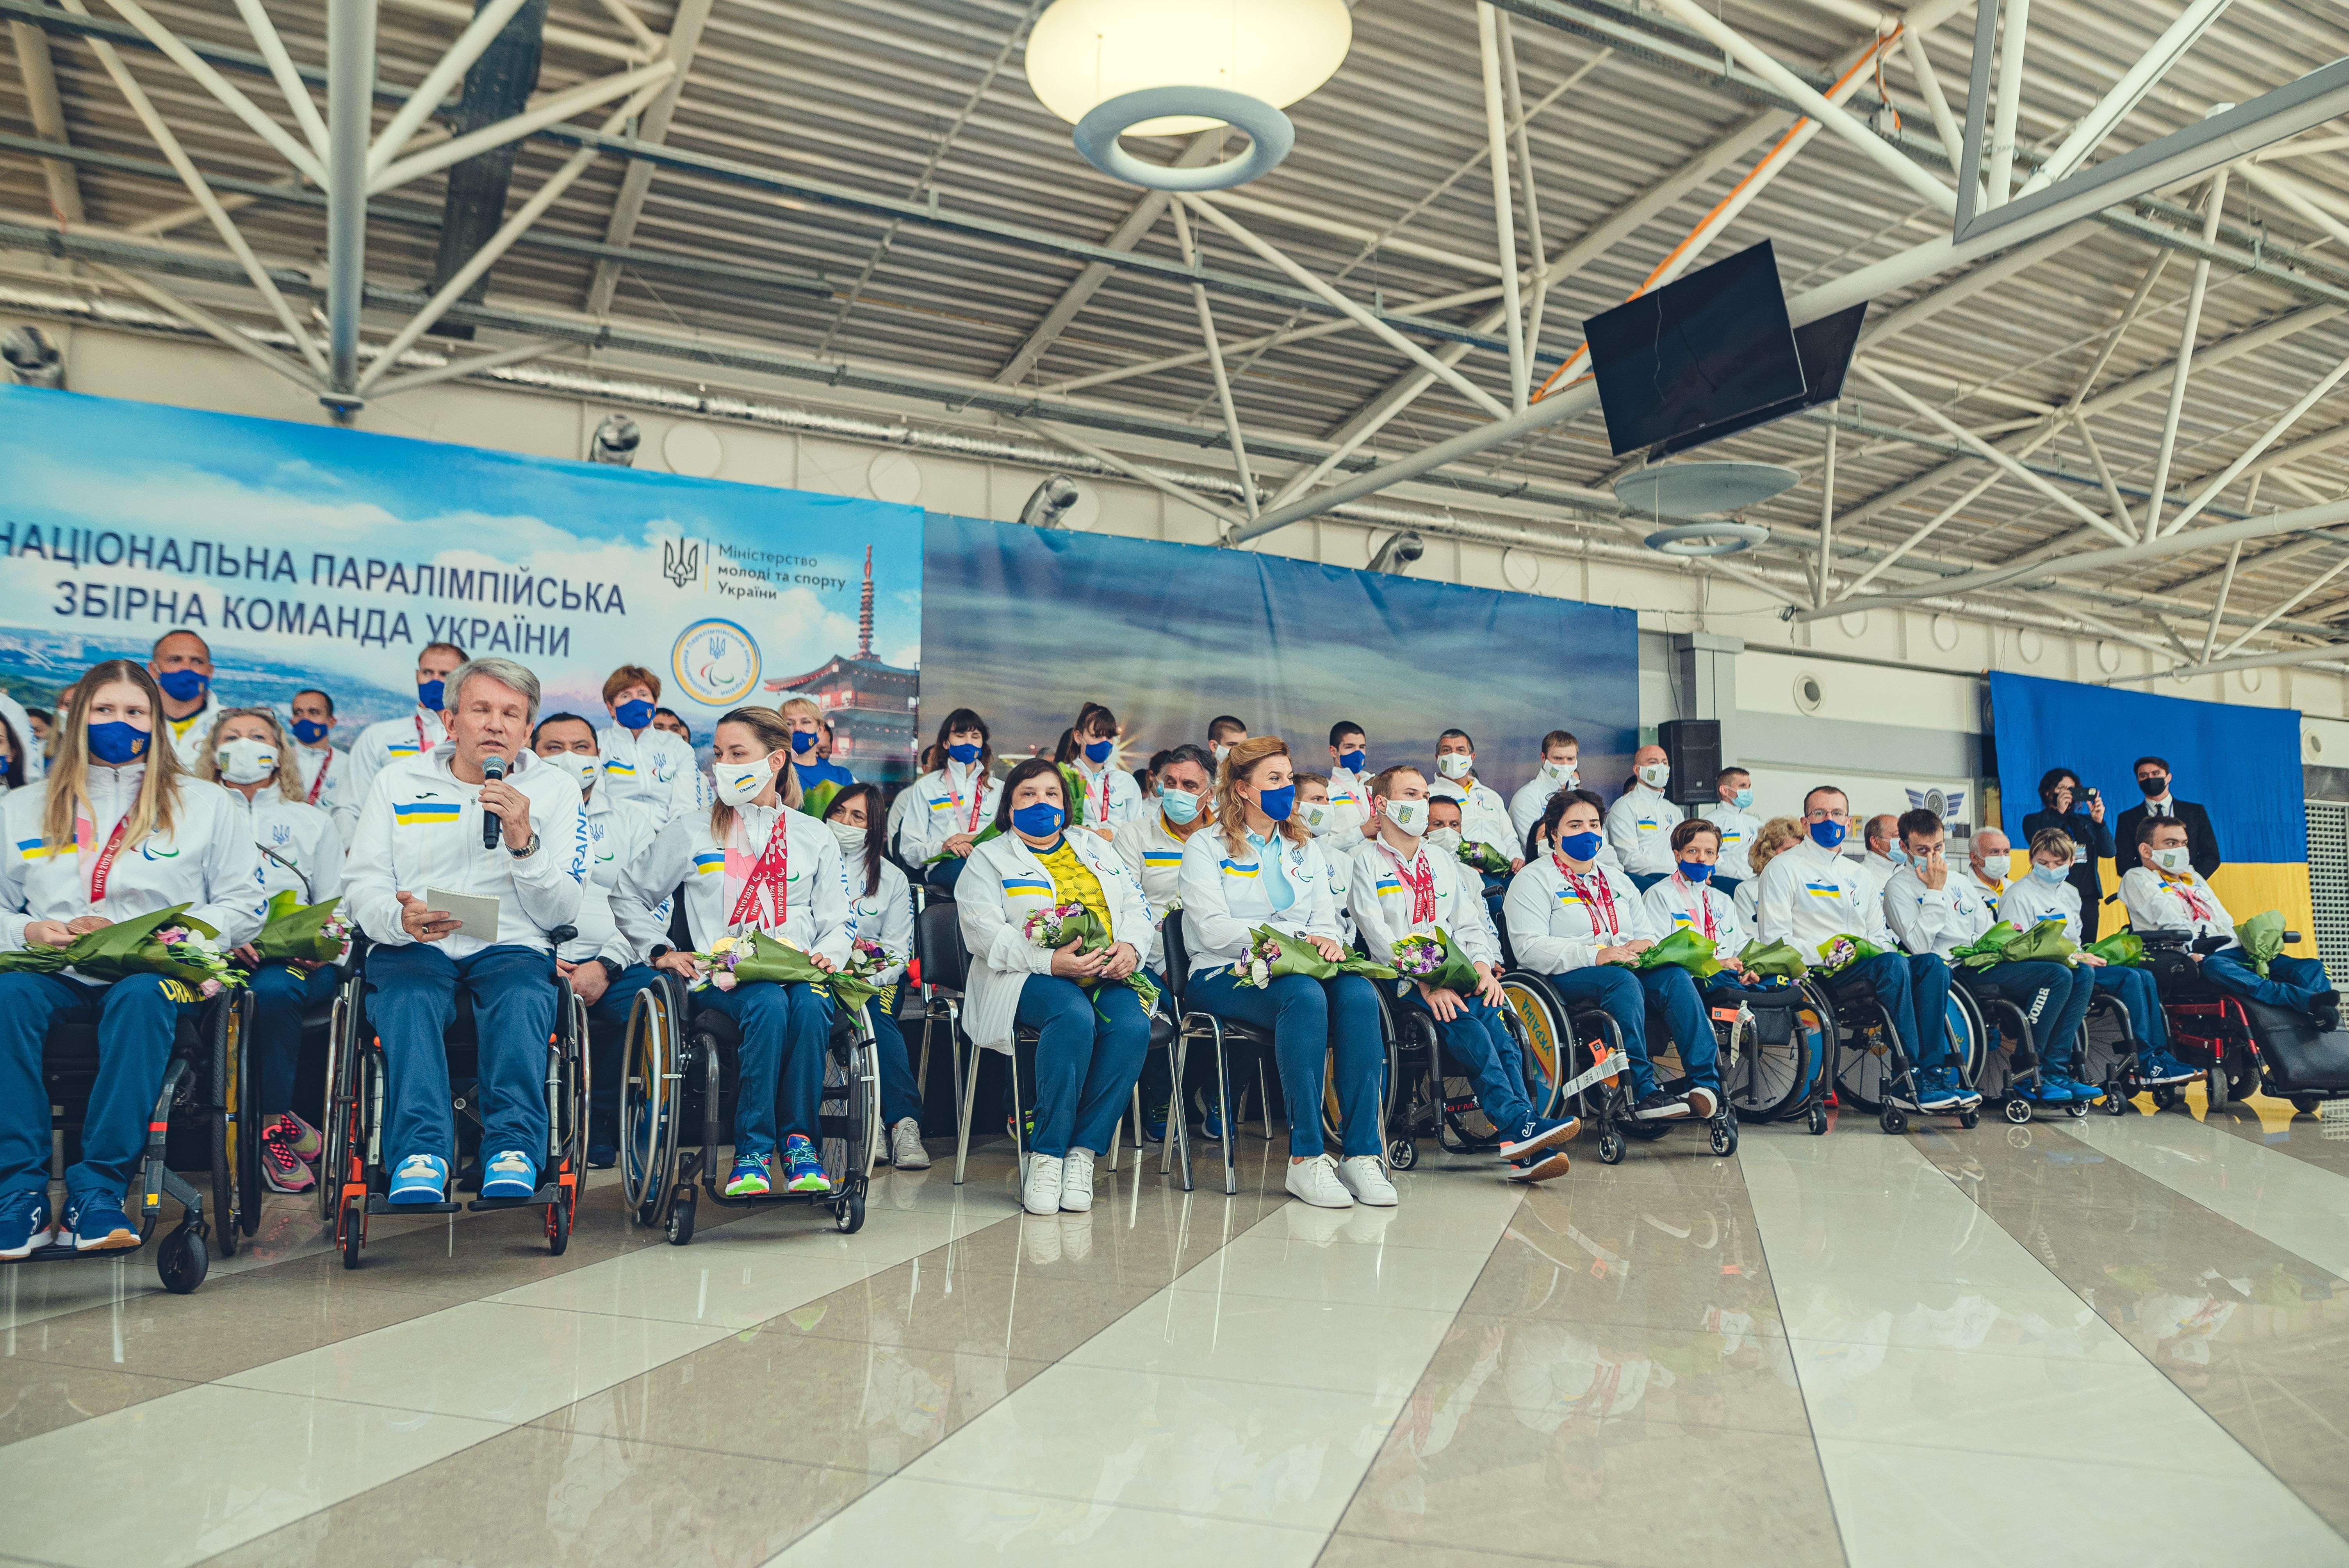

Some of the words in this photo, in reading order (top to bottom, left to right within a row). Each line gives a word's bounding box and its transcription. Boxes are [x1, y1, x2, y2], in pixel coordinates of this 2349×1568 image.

[0, 521, 298, 583] НАЦІОНАЛЬНА
[312, 553, 626, 615] ПАРАЛІМПІЙСЬКА
[719, 543, 818, 568] Міністерство
[718, 566, 771, 582] молоді
[775, 572, 790, 583] та
[795, 574, 847, 592] спорту
[718, 581, 777, 600] України
[53, 581, 207, 627] ЗБІРНА
[223, 596, 413, 648] КОМАНДА
[426, 613, 570, 657] УКРАЇНИ
[739, 783, 756, 793] Ukraine
[99, 853, 113, 870] 2020
[94, 869, 106, 893] TOKYO
[734, 899, 748, 918] TOKYO
[743, 884, 755, 900] 2020
[1522, 998, 1552, 1057] УКРАЇНА
